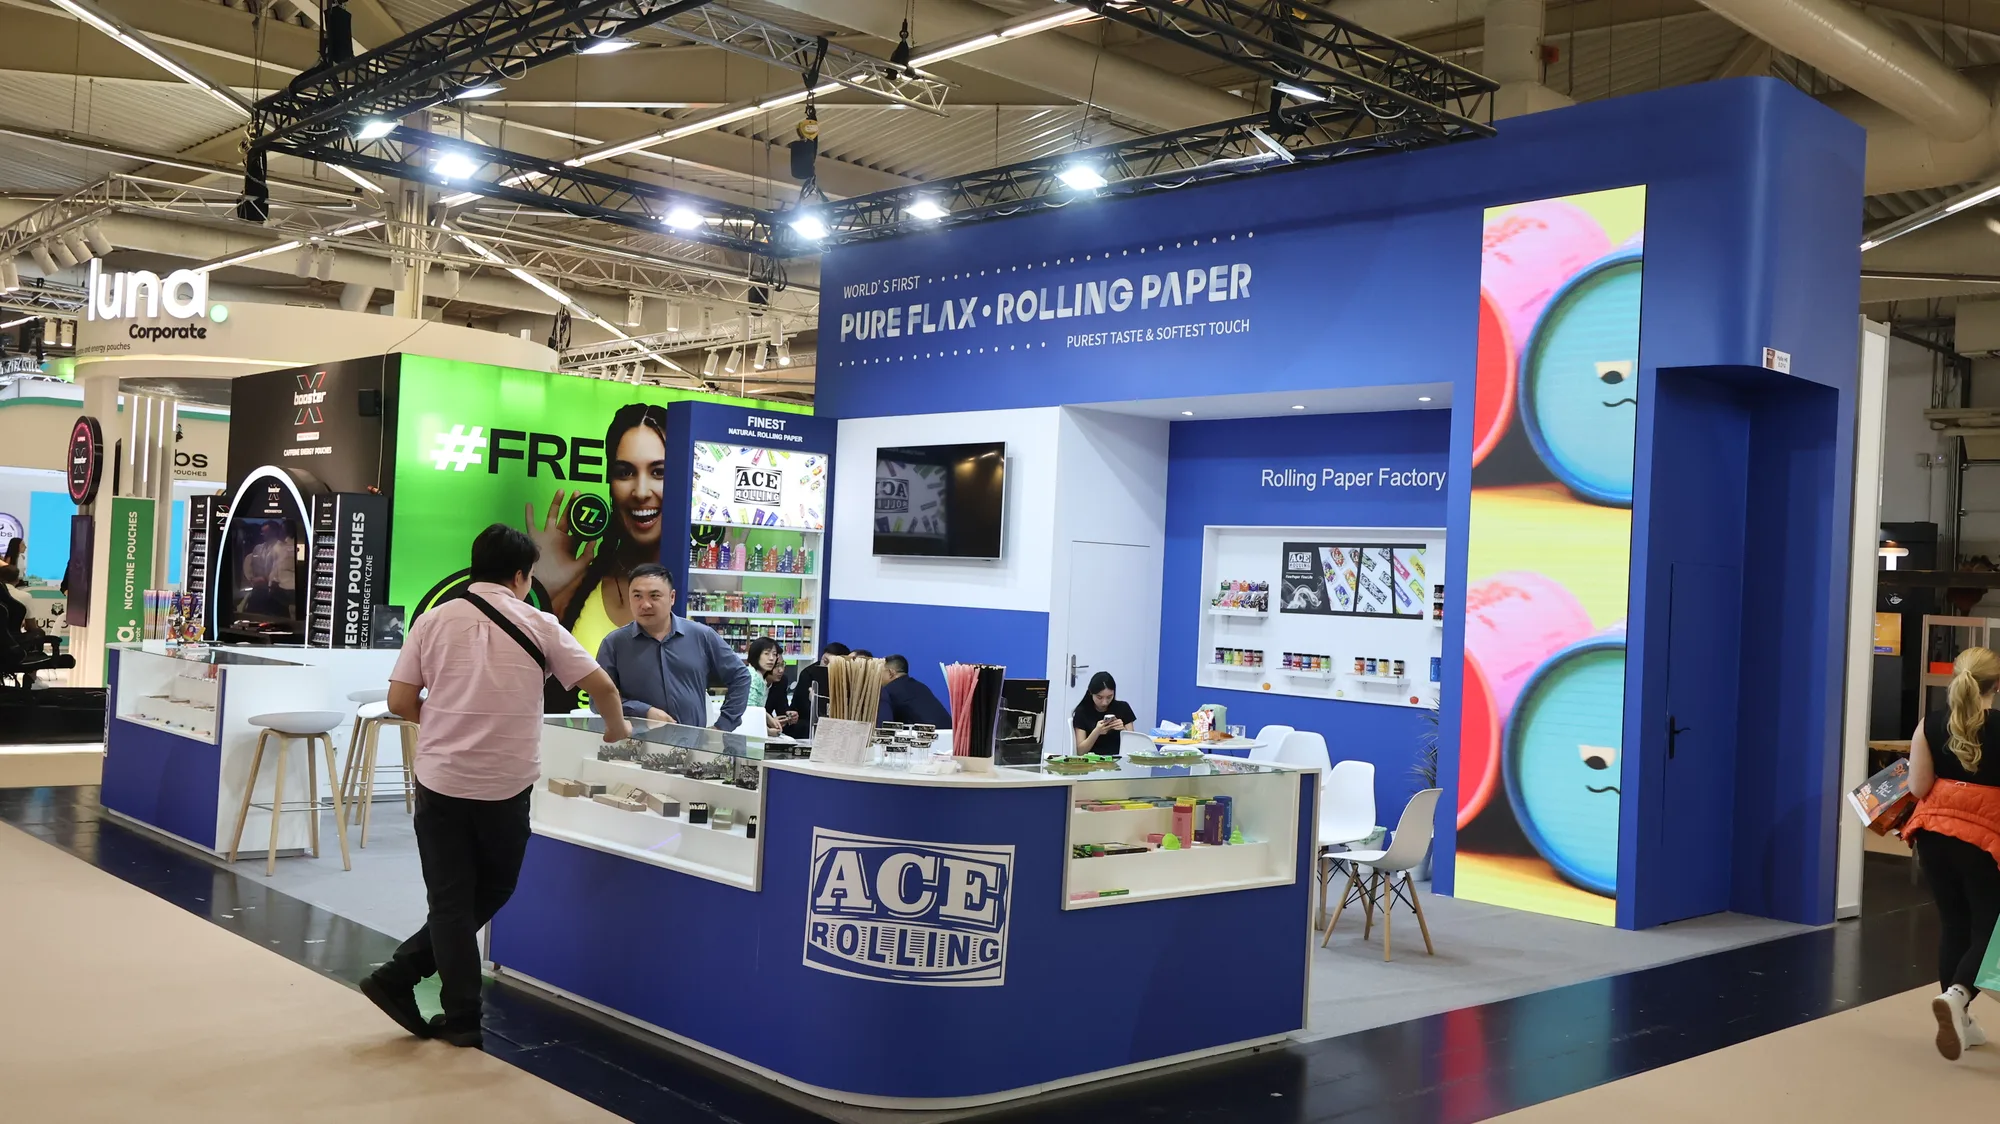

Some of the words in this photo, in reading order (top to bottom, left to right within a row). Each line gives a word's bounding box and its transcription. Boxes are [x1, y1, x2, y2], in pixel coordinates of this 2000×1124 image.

[891, 275, 920, 293] FIRST
[840, 306, 902, 343] PURE
[907, 296, 979, 336] FLAX
[996, 277, 1134, 325] ROLLING
[1140, 263, 1252, 310] PAPER
[129, 323, 207, 342] Corporate
[1066, 332, 1108, 349] PUREST
[1110, 329, 1143, 345] TASTE
[1145, 328, 1155, 341] &
[1156, 324, 1205, 341] SOFTEST
[1209, 319, 1250, 336] TOUCH
[107, 342, 131, 353] pouches
[294, 389, 327, 405] booster
[747, 416, 787, 431] FINEST
[728, 428, 756, 437] NATURAL
[757, 431, 783, 440] ROLLING
[784, 434, 803, 443] PAPER
[300, 447, 315, 456] ENERGY
[430, 424, 612, 484] #FRE
[174, 469, 207, 477] OUCHES
[738, 471, 778, 489] ACE
[1261, 468, 1317, 491] Rolling
[1322, 468, 1374, 491] Paper
[1378, 467, 1446, 491] Factory
[735, 489, 780, 502] ROLLING
[579, 505, 601, 524] 77
[126, 511, 138, 560] POUCHES
[348, 512, 365, 594] POUCHES
[1290, 554, 1309, 563] ACE
[124, 562, 136, 610] NICOTINE
[362, 555, 373, 621] ENERGETYCZNE
[345, 600, 360, 649] ERGY
[815, 849, 1001, 928] ACE
[811, 922, 1000, 968] ROLLING
